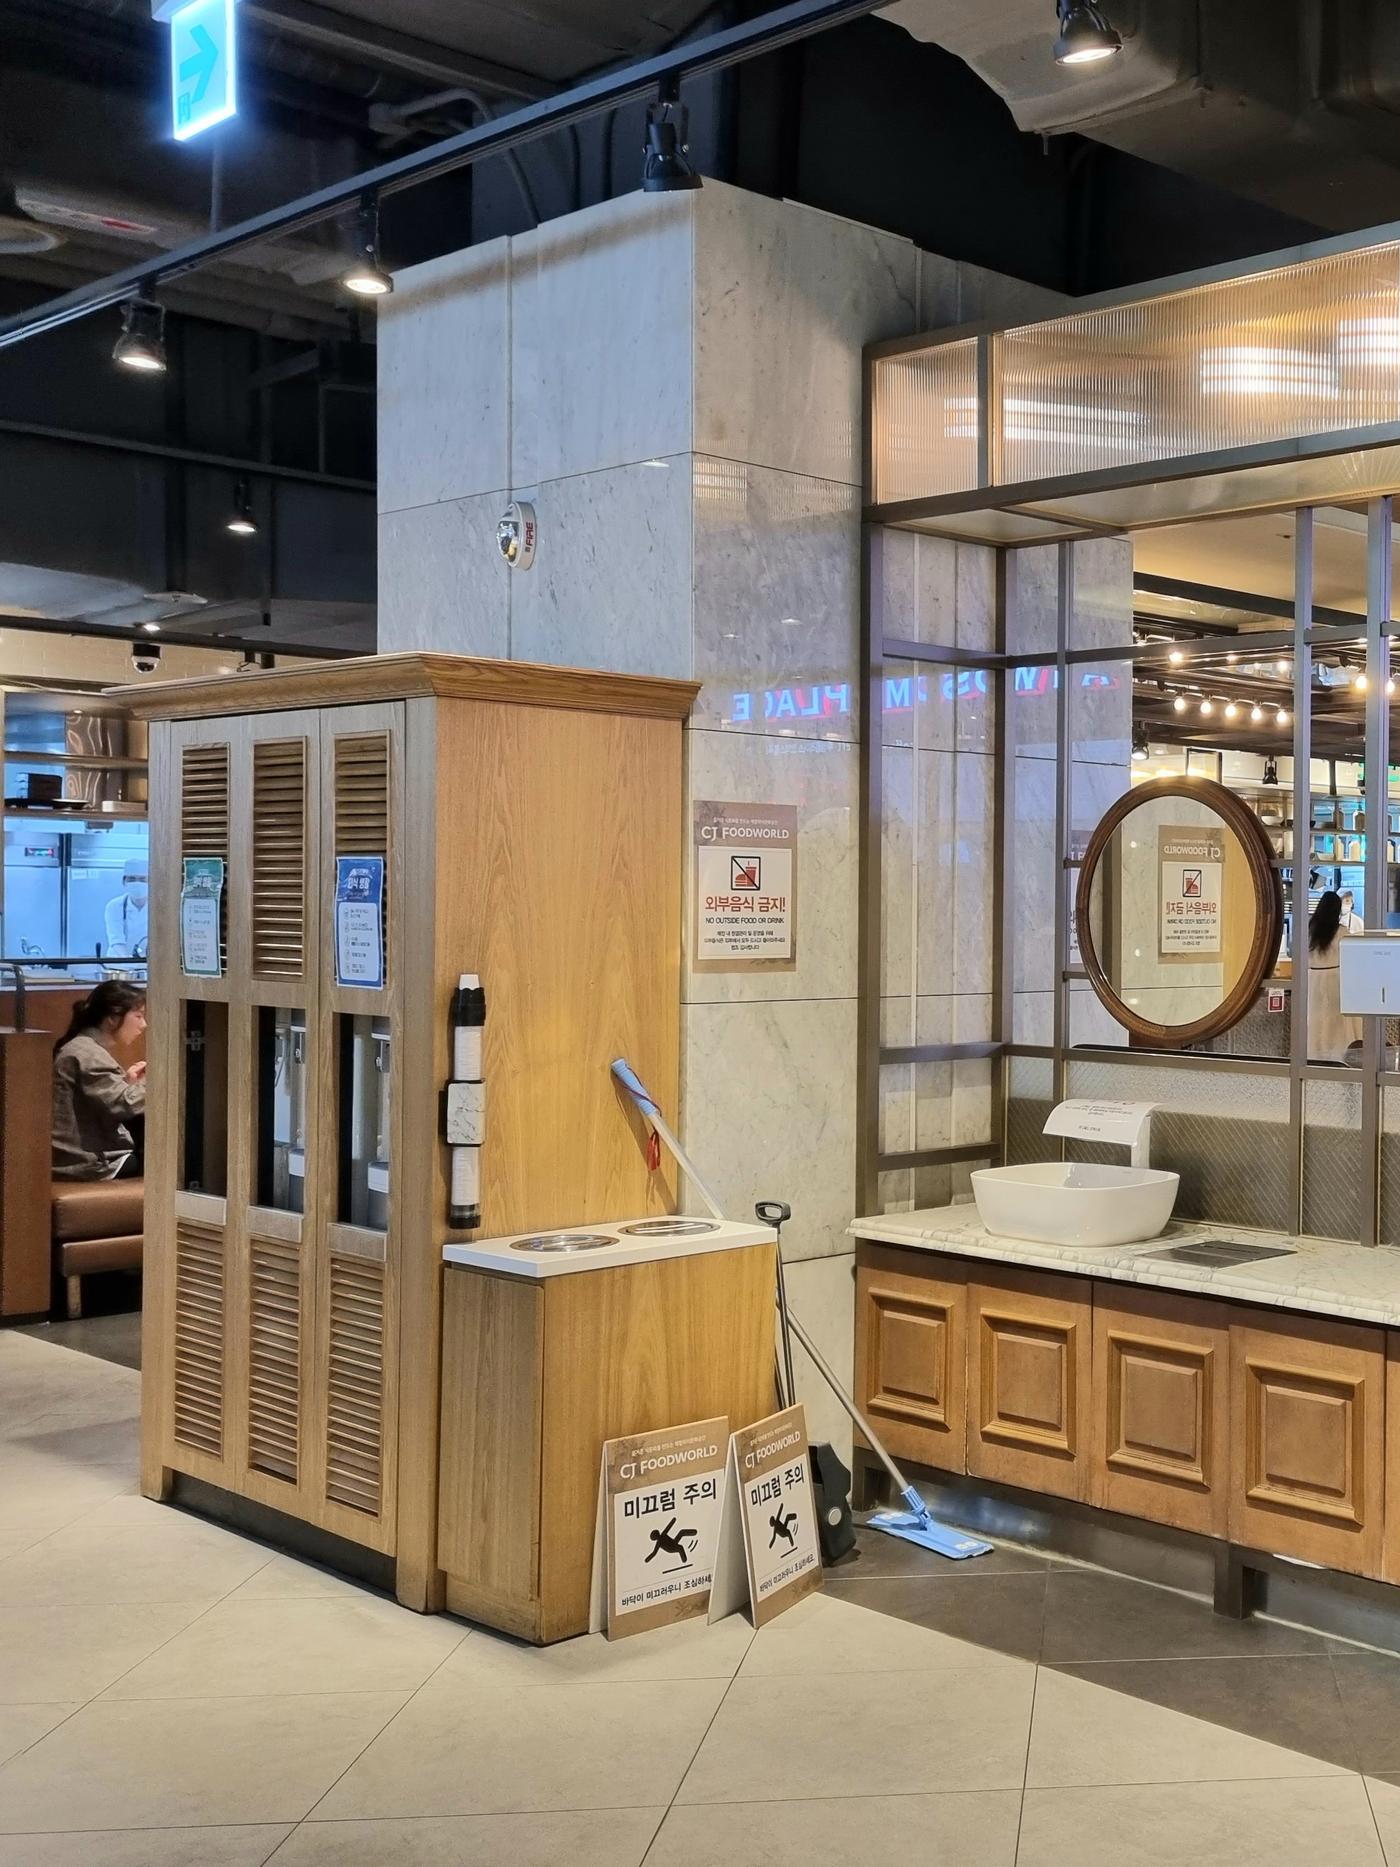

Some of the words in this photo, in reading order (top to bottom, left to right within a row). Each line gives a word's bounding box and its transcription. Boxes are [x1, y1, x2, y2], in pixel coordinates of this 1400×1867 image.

[701, 826, 718, 841] CJ
[722, 827, 789, 840] FOODWORLD
[705, 896, 754, 912] 외부음식
[758, 896, 786, 912] 금지!
[620, 1463, 636, 1480] CJ
[640, 1445, 718, 1475] FOODWORLD
[745, 1454, 755, 1469] CJ
[756, 1431, 801, 1463] FOODWORLD
[624, 1488, 676, 1519] 미끄럼
[683, 1478, 716, 1505] 주의
[751, 1475, 781, 1507] 미끄럼
[785, 1463, 805, 1490] 주의
[621, 1593, 645, 1606] 바닥이
[646, 1581, 682, 1600] 미끄러우니
[683, 1573, 713, 1590] 조심하세
